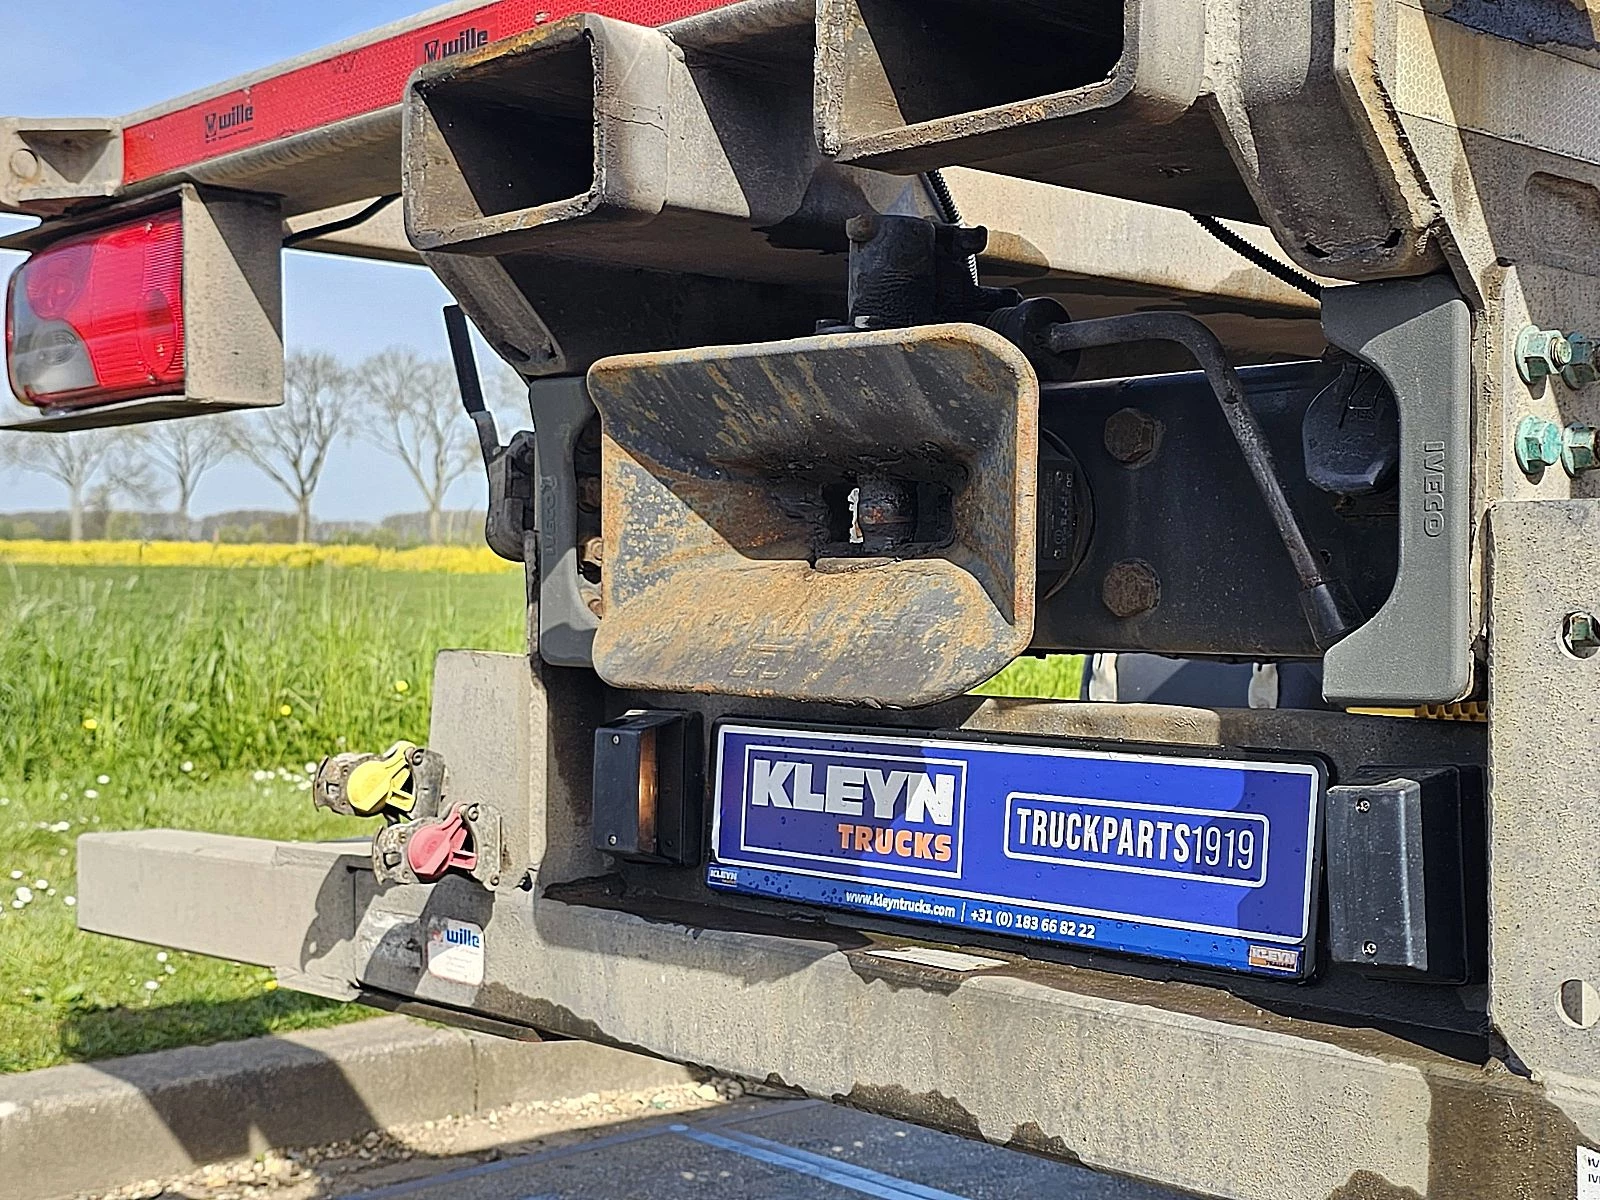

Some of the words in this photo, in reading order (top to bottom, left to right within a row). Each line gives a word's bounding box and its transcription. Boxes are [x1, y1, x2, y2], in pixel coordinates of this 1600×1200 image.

[442, 28, 488, 58] wille
[219, 104, 253, 130] wille
[1422, 441, 1445, 537] IVECO
[752, 759, 955, 826] KLEYN
[838, 823, 952, 862] TRUCKS
[1017, 807, 1255, 870] TRUCKPARTS1919
[846, 891, 956, 918] www.kleyntrucks.com
[970, 908, 993, 923] +31
[996, 910, 1013, 928] (0)
[1015, 914, 1039, 930] 183
[1041, 917, 1058, 933] 66
[1059, 919, 1076, 936] 82
[1077, 922, 1096, 939] 22
[446, 928, 480, 948] wille
[1588, 1173, 1600, 1184] IV
